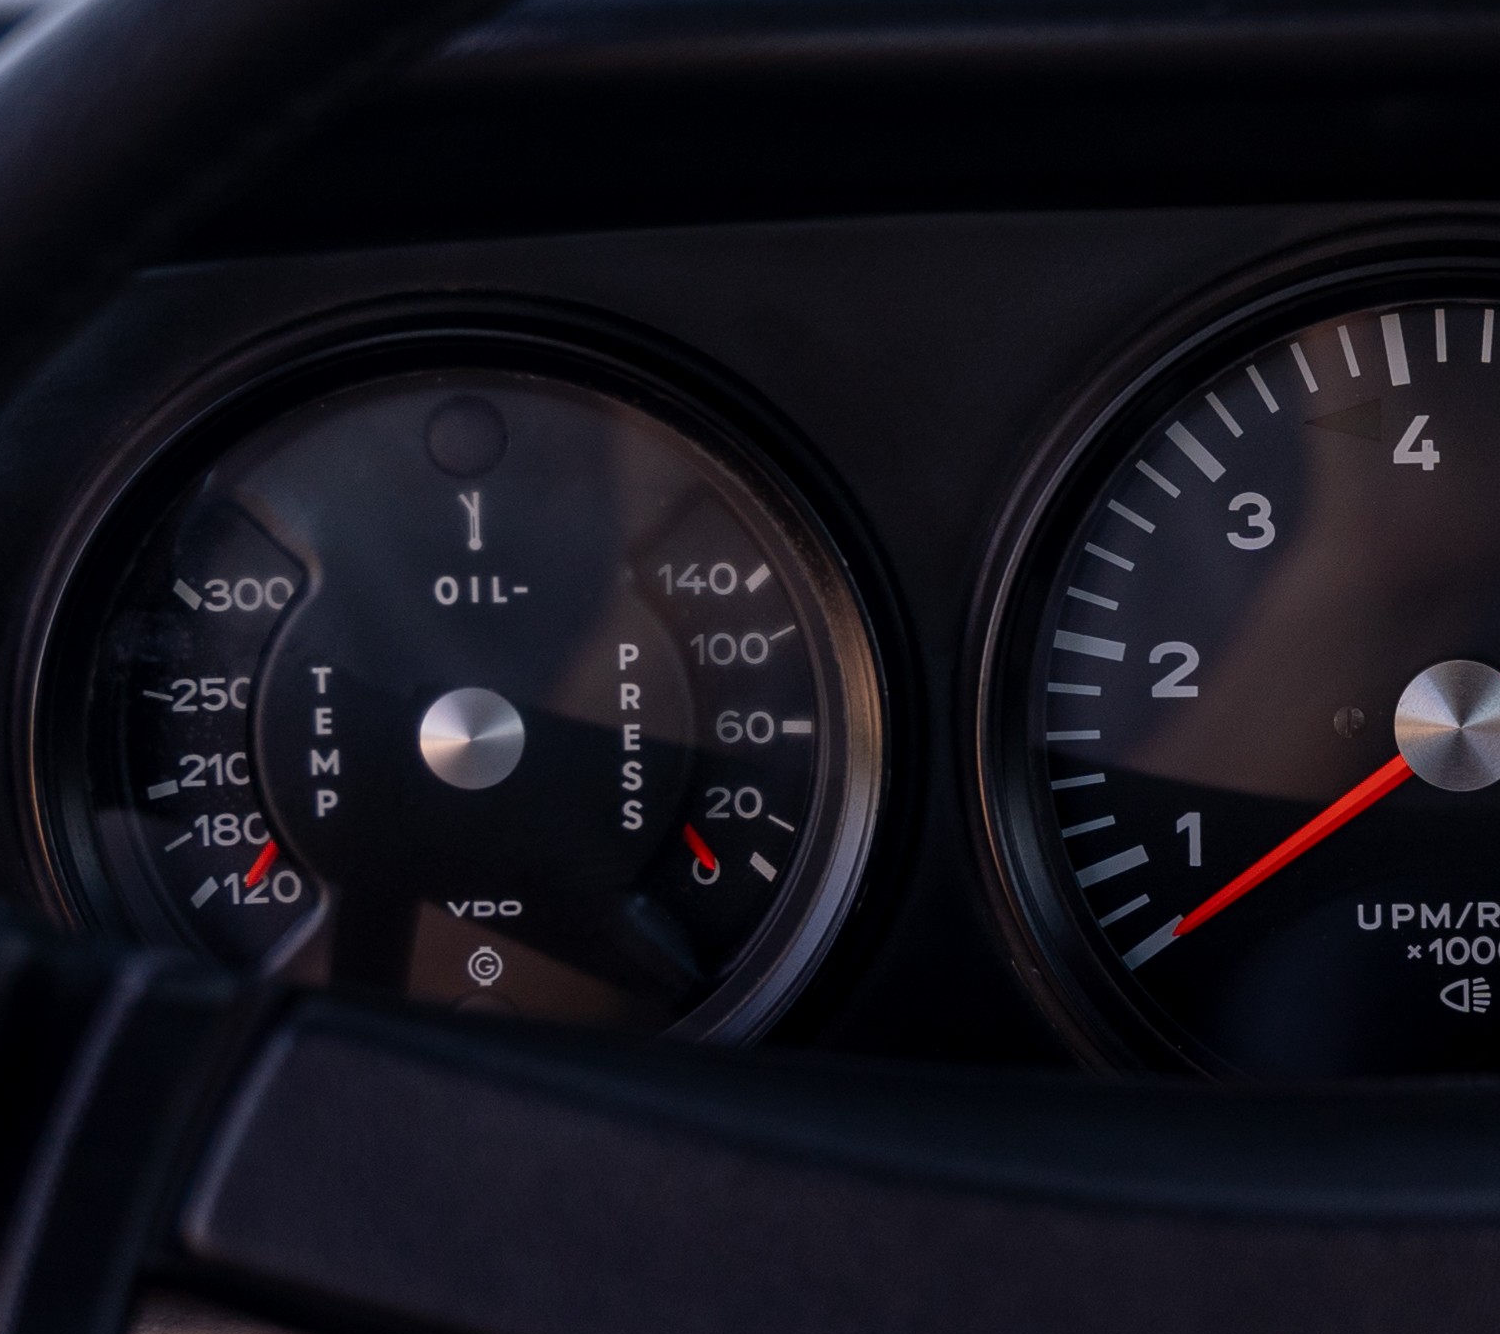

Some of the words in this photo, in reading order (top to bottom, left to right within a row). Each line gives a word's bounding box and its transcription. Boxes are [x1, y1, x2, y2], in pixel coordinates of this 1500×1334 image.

[1393, 414, 1441, 471] 4
[1226, 492, 1277, 550] 3
[203, 576, 295, 612] 300
[658, 562, 738, 597] 140
[690, 631, 770, 666] 100
[1149, 640, 1200, 699] 2
[310, 666, 341, 818] TEMP
[619, 642, 644, 832] PRESS
[716, 710, 774, 745] 60
[705, 787, 763, 820] 20
[194, 811, 270, 847] 180
[1175, 811, 1202, 867] 1
[223, 869, 303, 906] 120
[446, 899, 523, 918] VDO
